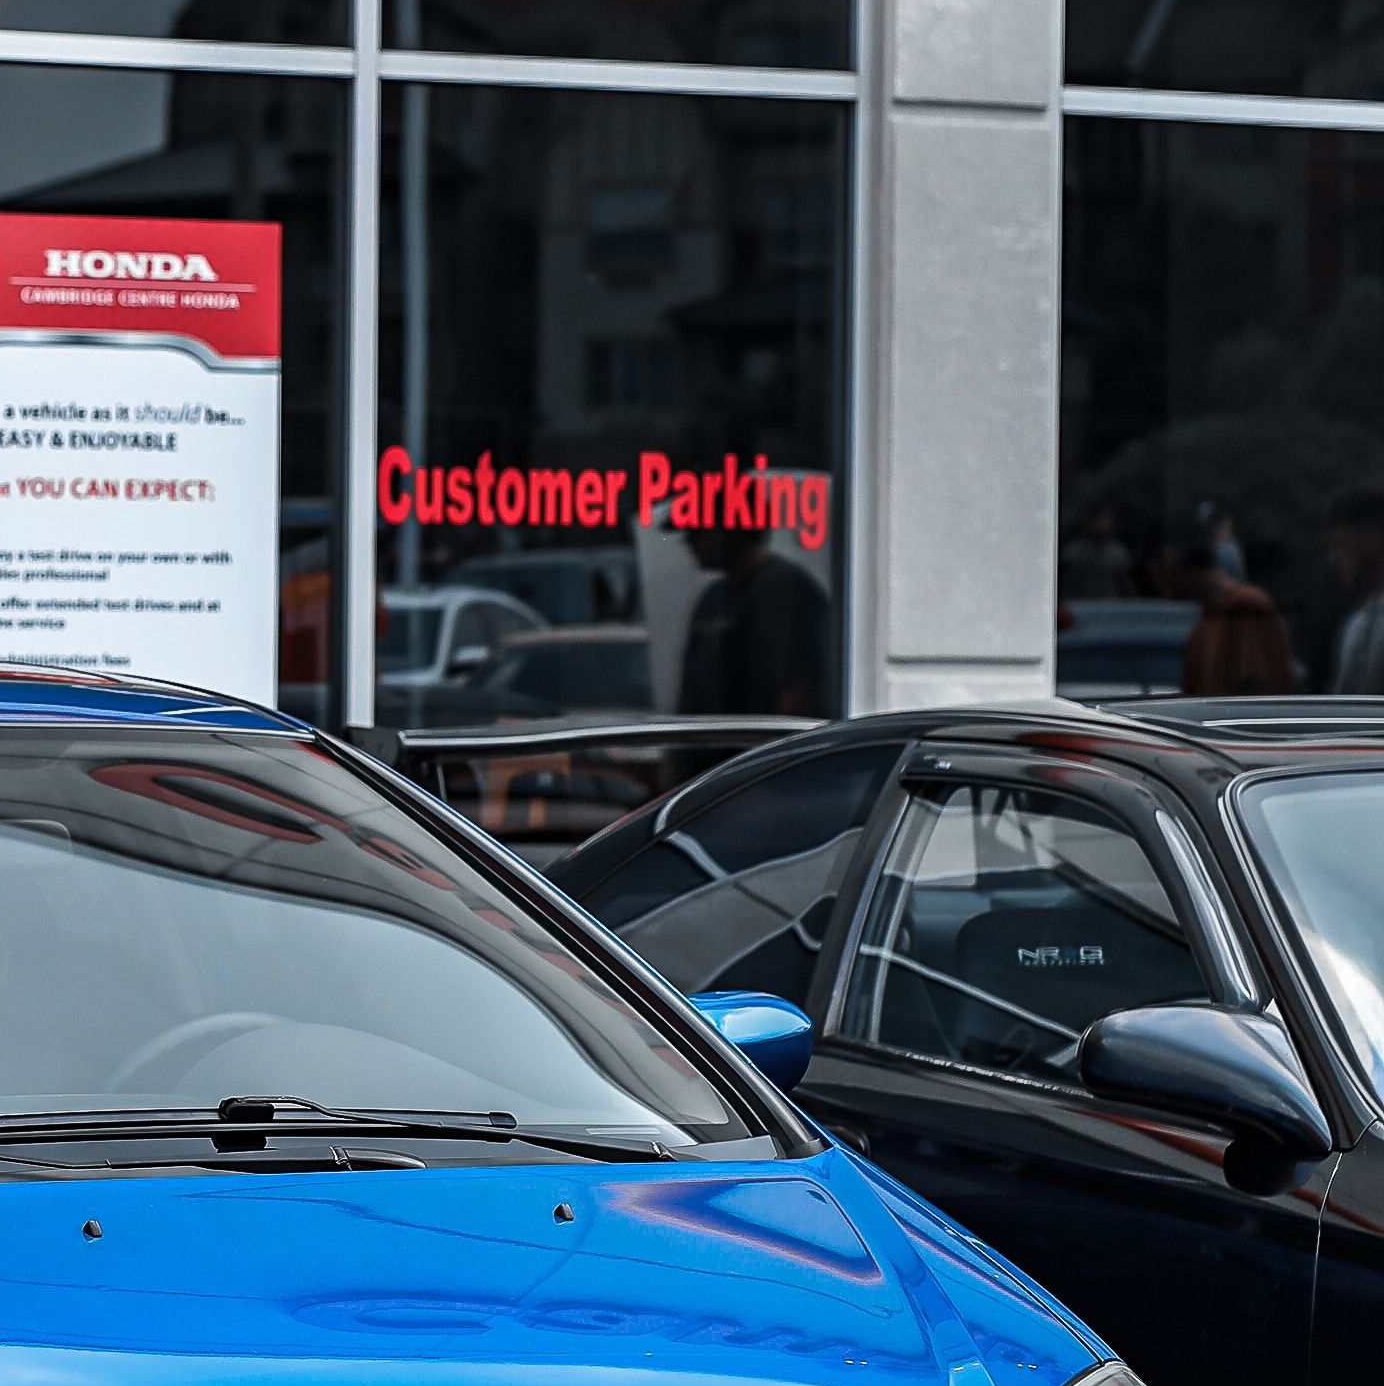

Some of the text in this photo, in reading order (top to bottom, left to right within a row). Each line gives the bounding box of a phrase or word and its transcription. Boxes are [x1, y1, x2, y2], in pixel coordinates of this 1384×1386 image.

[44, 249, 219, 281] HONDA
[181, 292, 240, 309] HONDA
[4, 404, 14, 419] a
[19, 401, 87, 420] vehicle
[91, 406, 110, 421] as
[115, 401, 129, 421] it
[134, 401, 202, 424] should
[49, 429, 64, 450] &
[67, 430, 178, 452] ENJOYABLE
[16, 476, 65, 500] YOU
[69, 477, 119, 500] CAN
[378, 445, 829, 550] Customer Parking
